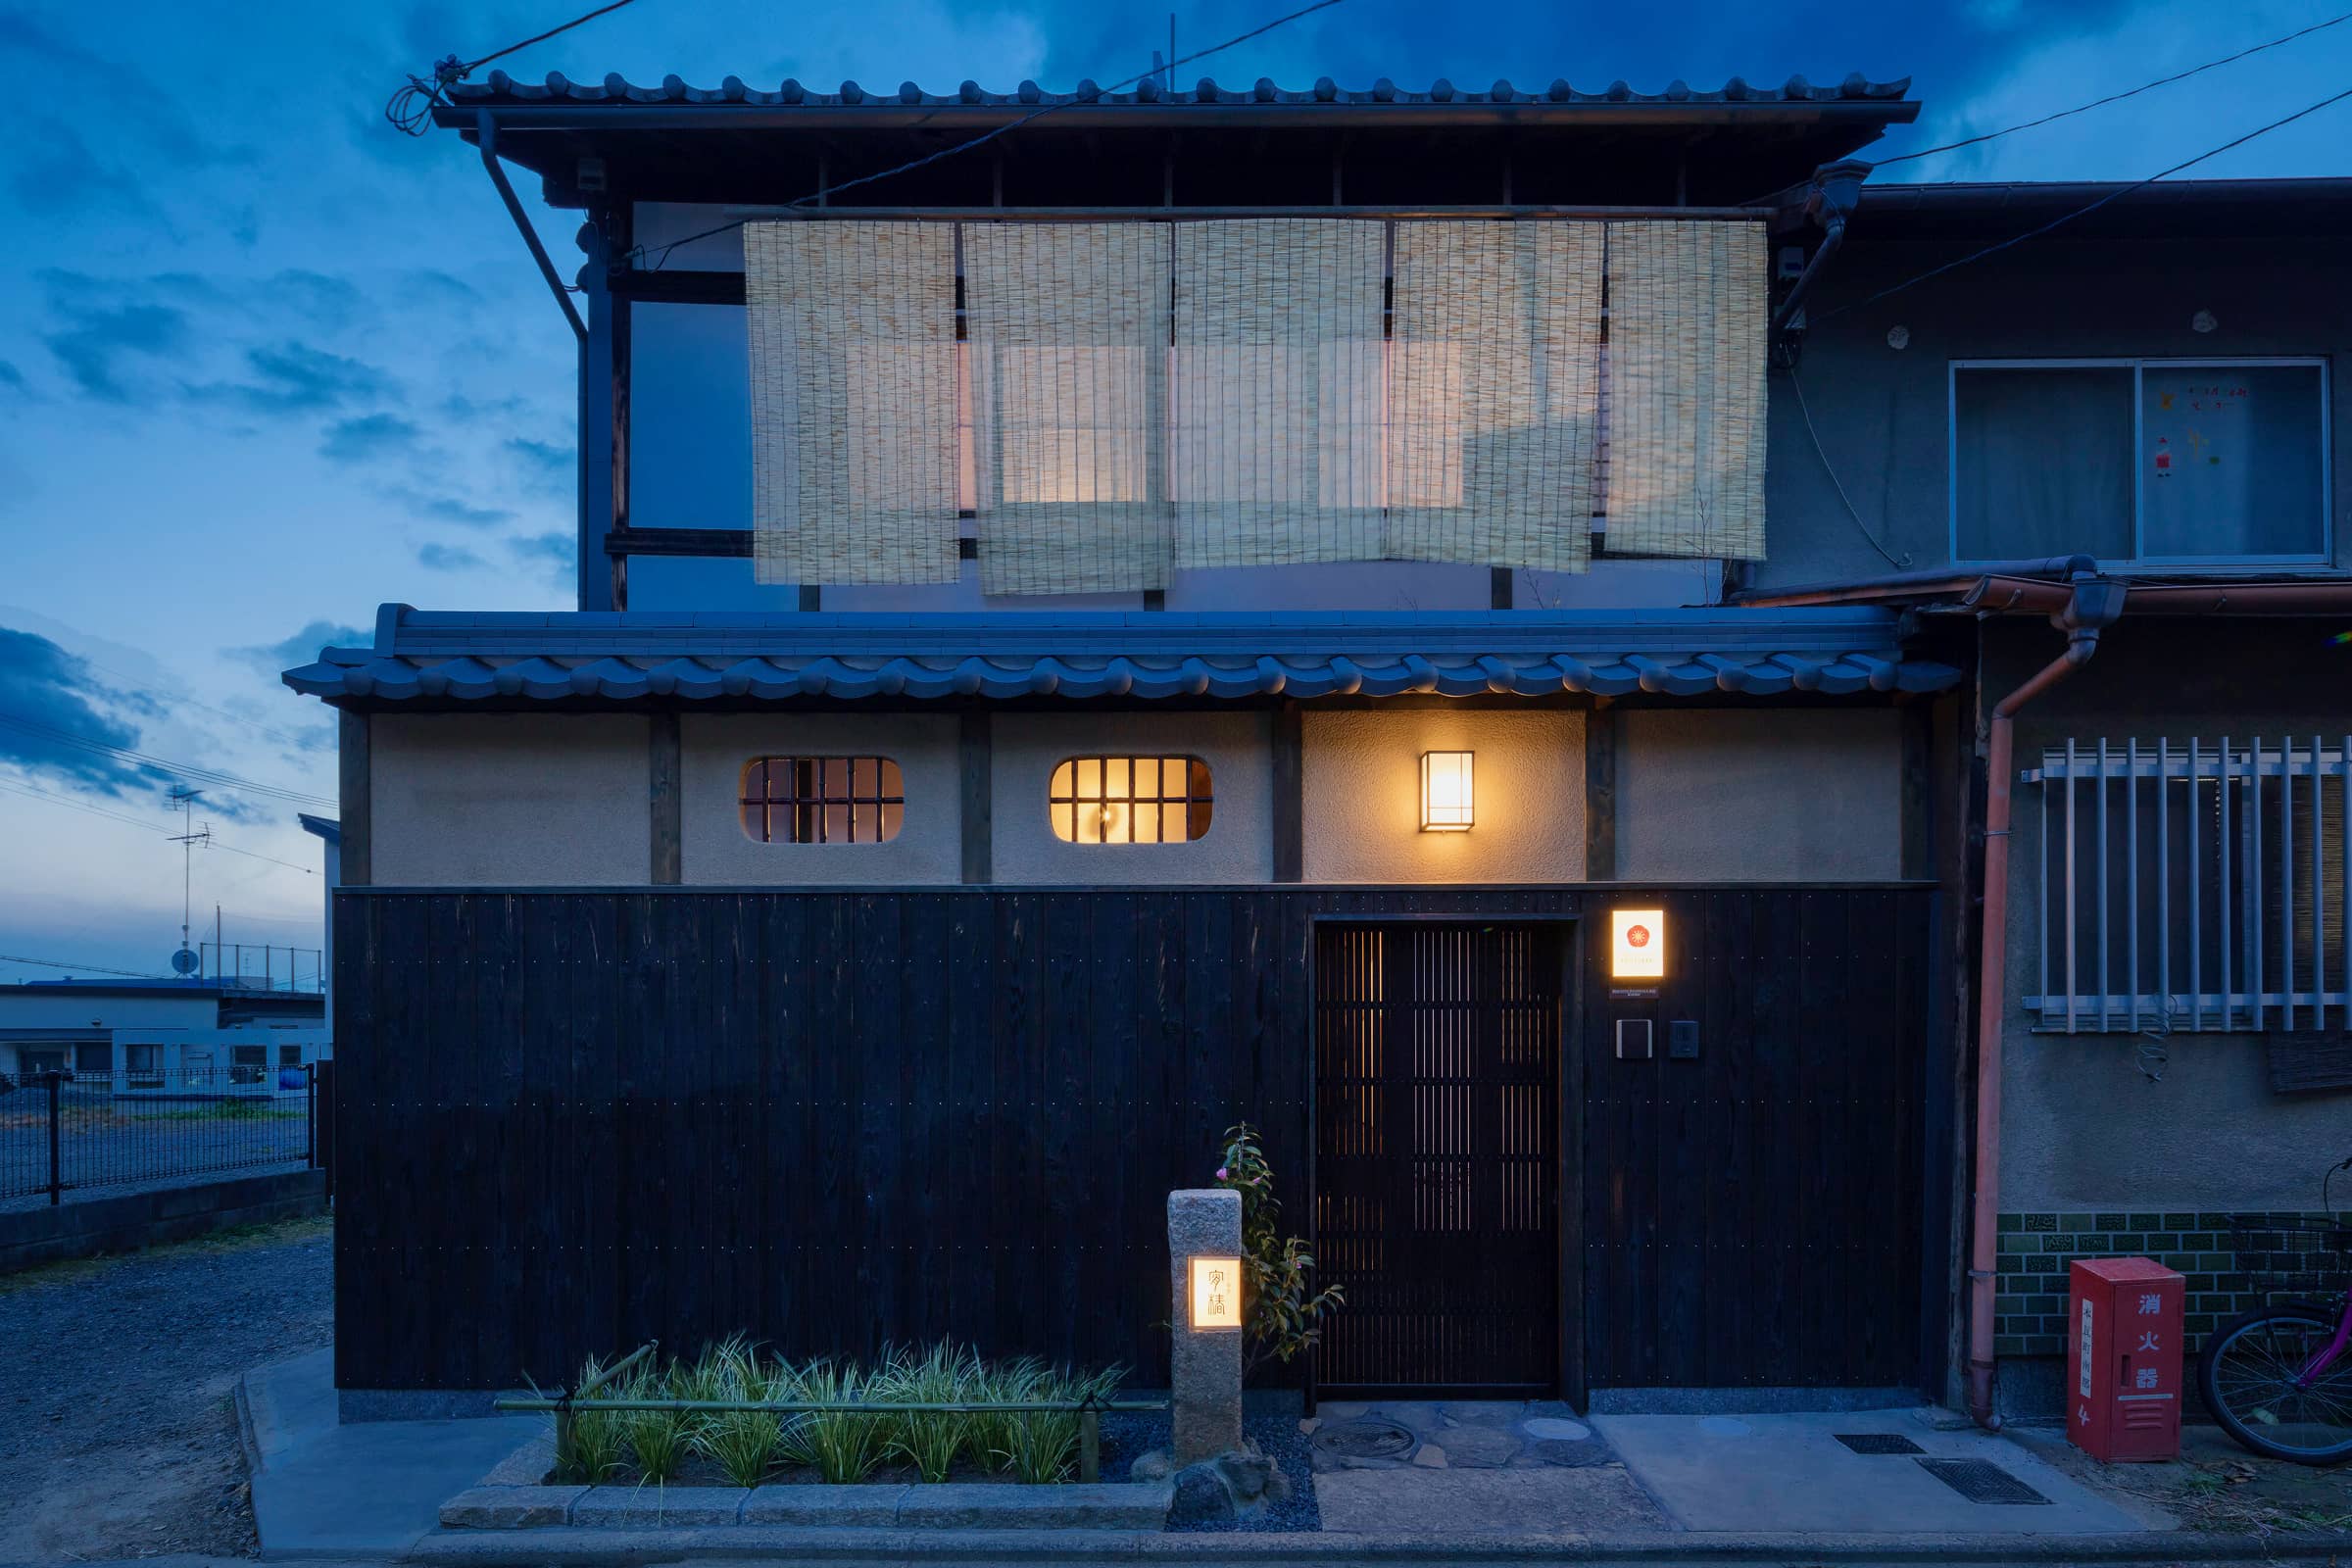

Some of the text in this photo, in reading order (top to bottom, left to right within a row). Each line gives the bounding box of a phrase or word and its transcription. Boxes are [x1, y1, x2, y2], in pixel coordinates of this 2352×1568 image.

[2136, 1294, 2161, 1389] 消火器
[2078, 1403, 2090, 1427] 4
